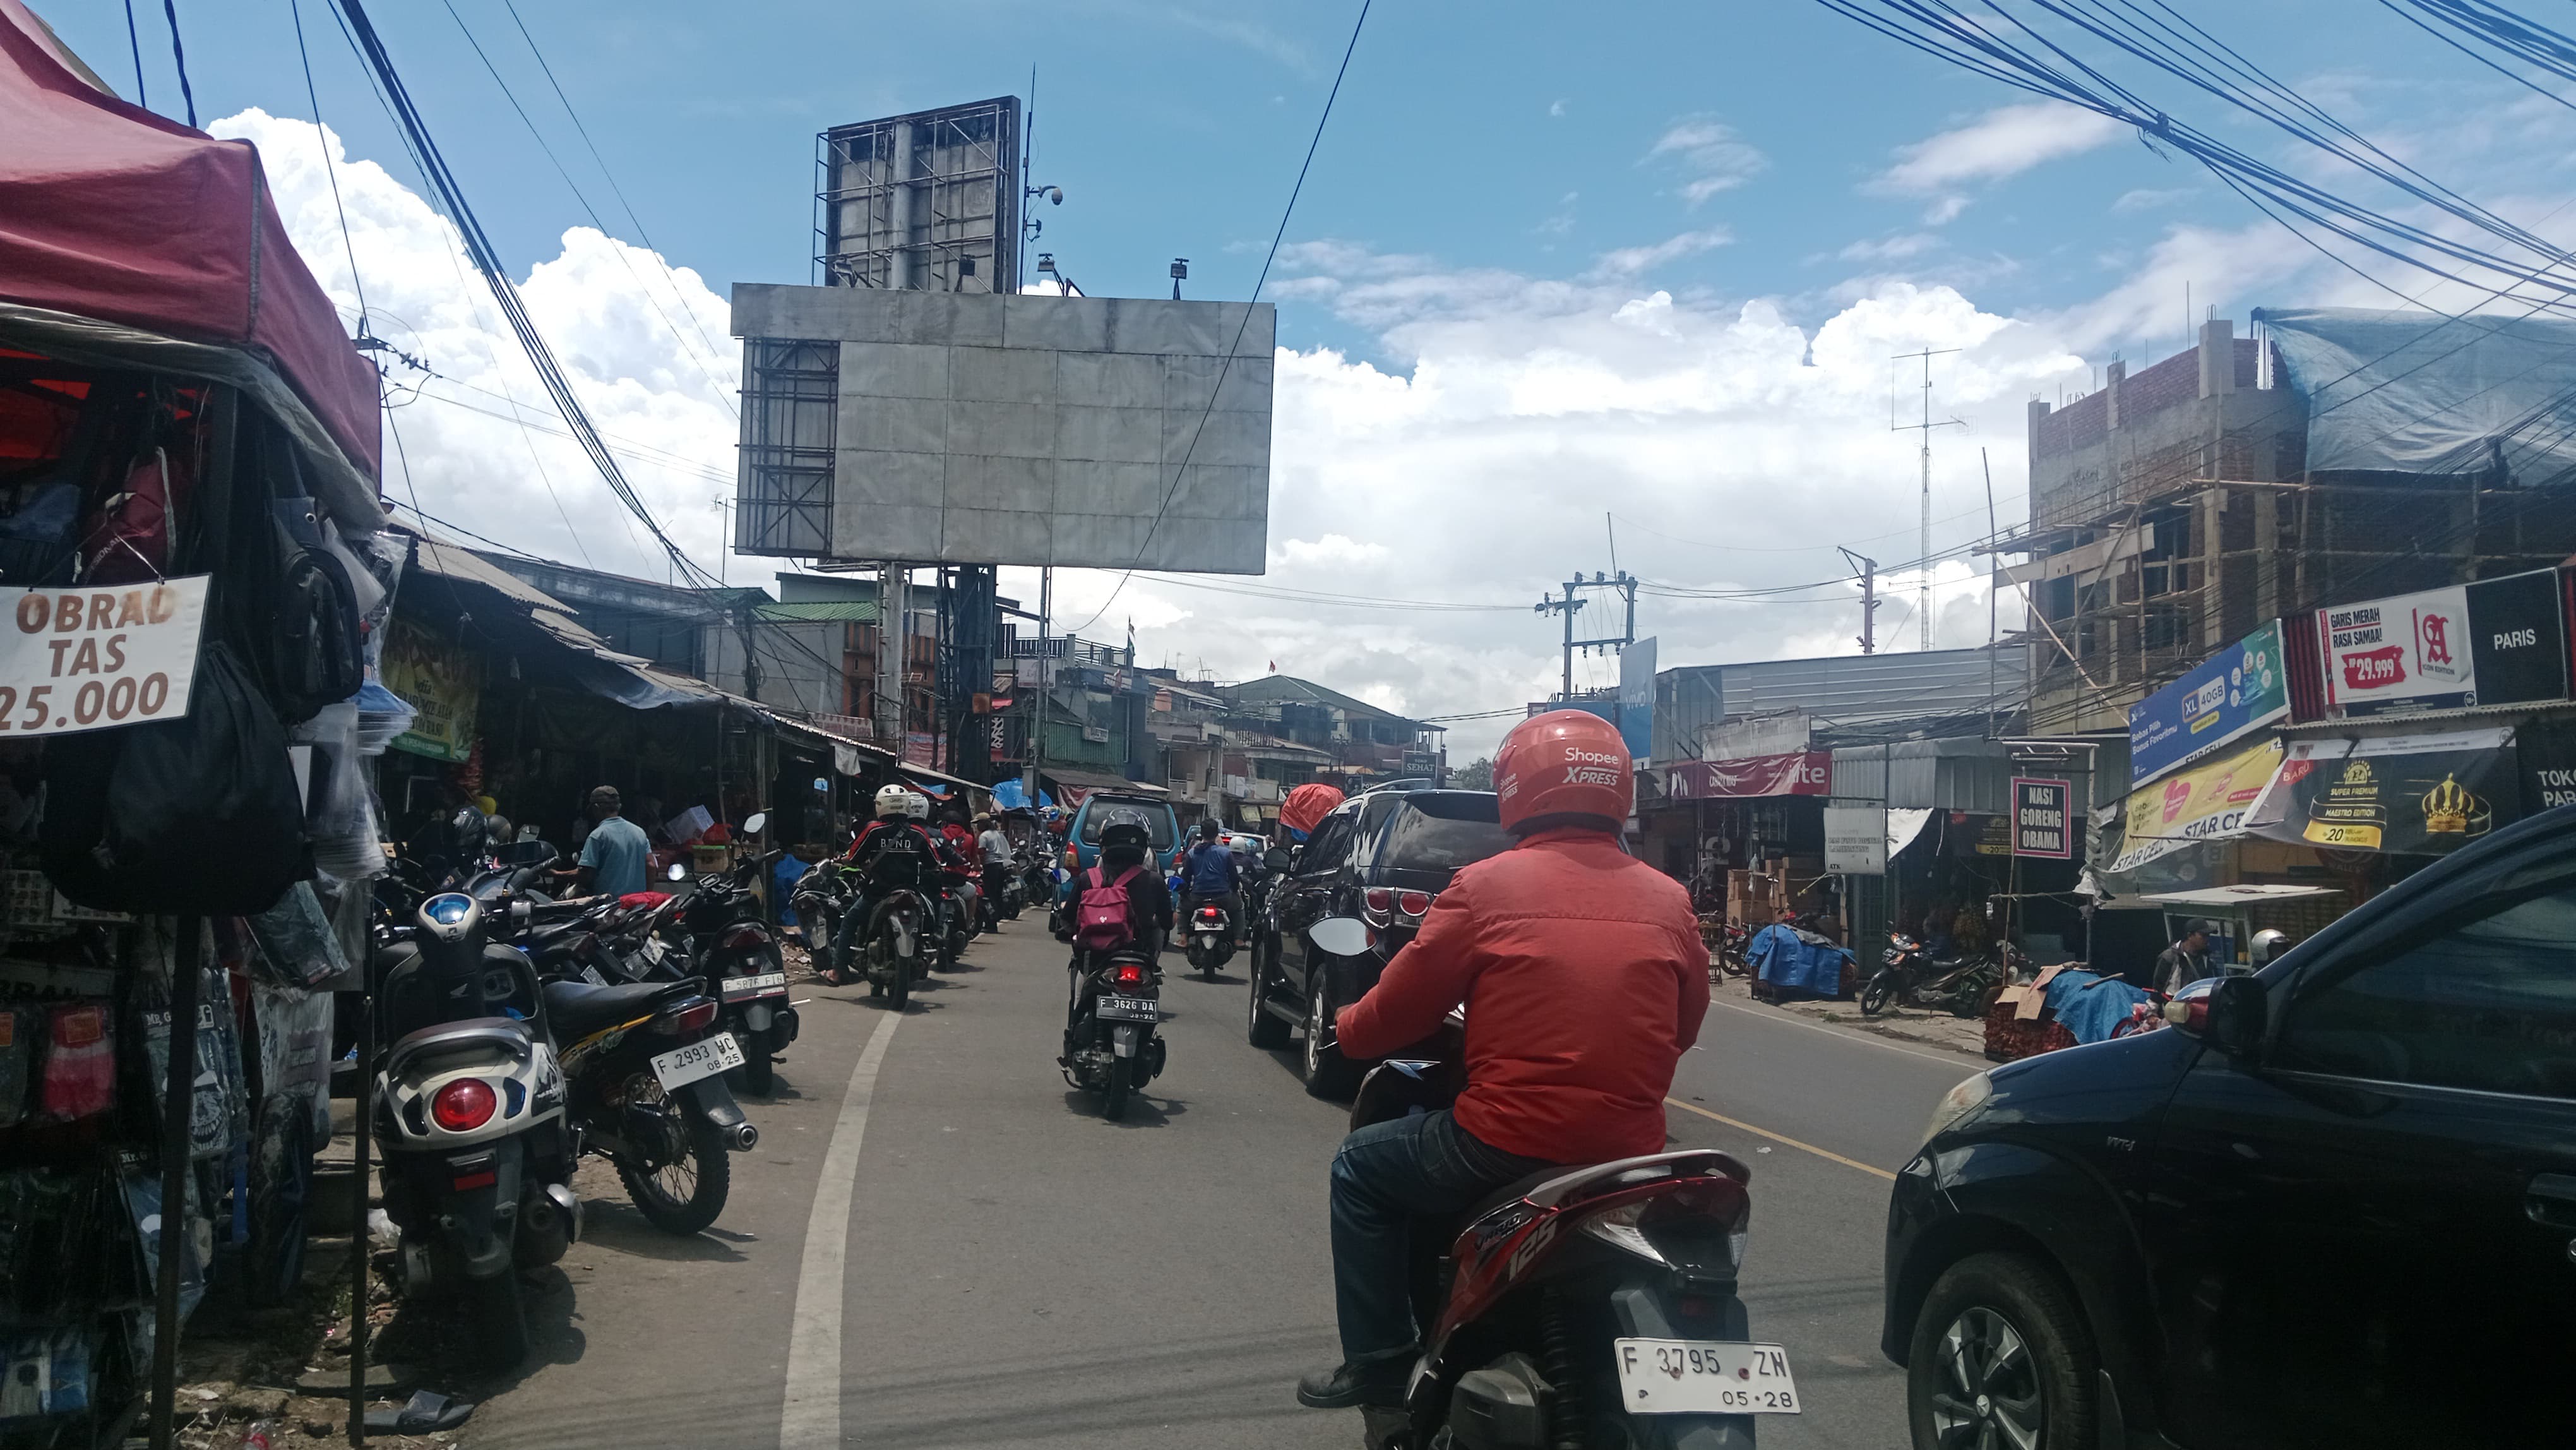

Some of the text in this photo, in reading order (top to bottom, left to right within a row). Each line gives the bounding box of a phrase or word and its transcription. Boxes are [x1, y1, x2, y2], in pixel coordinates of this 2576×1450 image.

[2330, 606, 2380, 628] GARIS MERAH
[2332, 627, 2383, 648] RASA SAMAA!
[2494, 628, 2536, 650] PARIS
[49, 634, 127, 678] TAS
[2435, 666, 2455, 676] EDITION
[0, 672, 169, 731] 25.000
[2185, 685, 2224, 716] XL 40GB
[2132, 719, 2161, 743] Bebas Pilih
[2132, 724, 2178, 755] Bonus Favoritmu
[1565, 746, 1618, 765] Shopee
[1406, 763, 1435, 772] SEHAT
[1563, 766, 1621, 786] XPRESS
[2282, 760, 2310, 782] BARU
[2537, 768, 2576, 787] TOK
[1500, 773, 1516, 789] Shopee
[2330, 786, 2378, 796] SUPER PREMIUM
[2029, 786, 2054, 806] NASI
[2020, 808, 2062, 828] GORENG
[2353, 809, 2376, 817] EDITION
[2185, 815, 2218, 837] STAR
[2326, 828, 2344, 842] 20
[2022, 830, 2060, 849] OBAMA
[2116, 849, 2142, 871] STAR
[725, 983, 731, 992] F
[1100, 998, 1154, 1012] F 3626 DA
[657, 1058, 667, 1075] F
[677, 1045, 710, 1067] 2993
[1509, 1216, 1558, 1282] 125
[1623, 1346, 1788, 1378] F 3795 ZN
